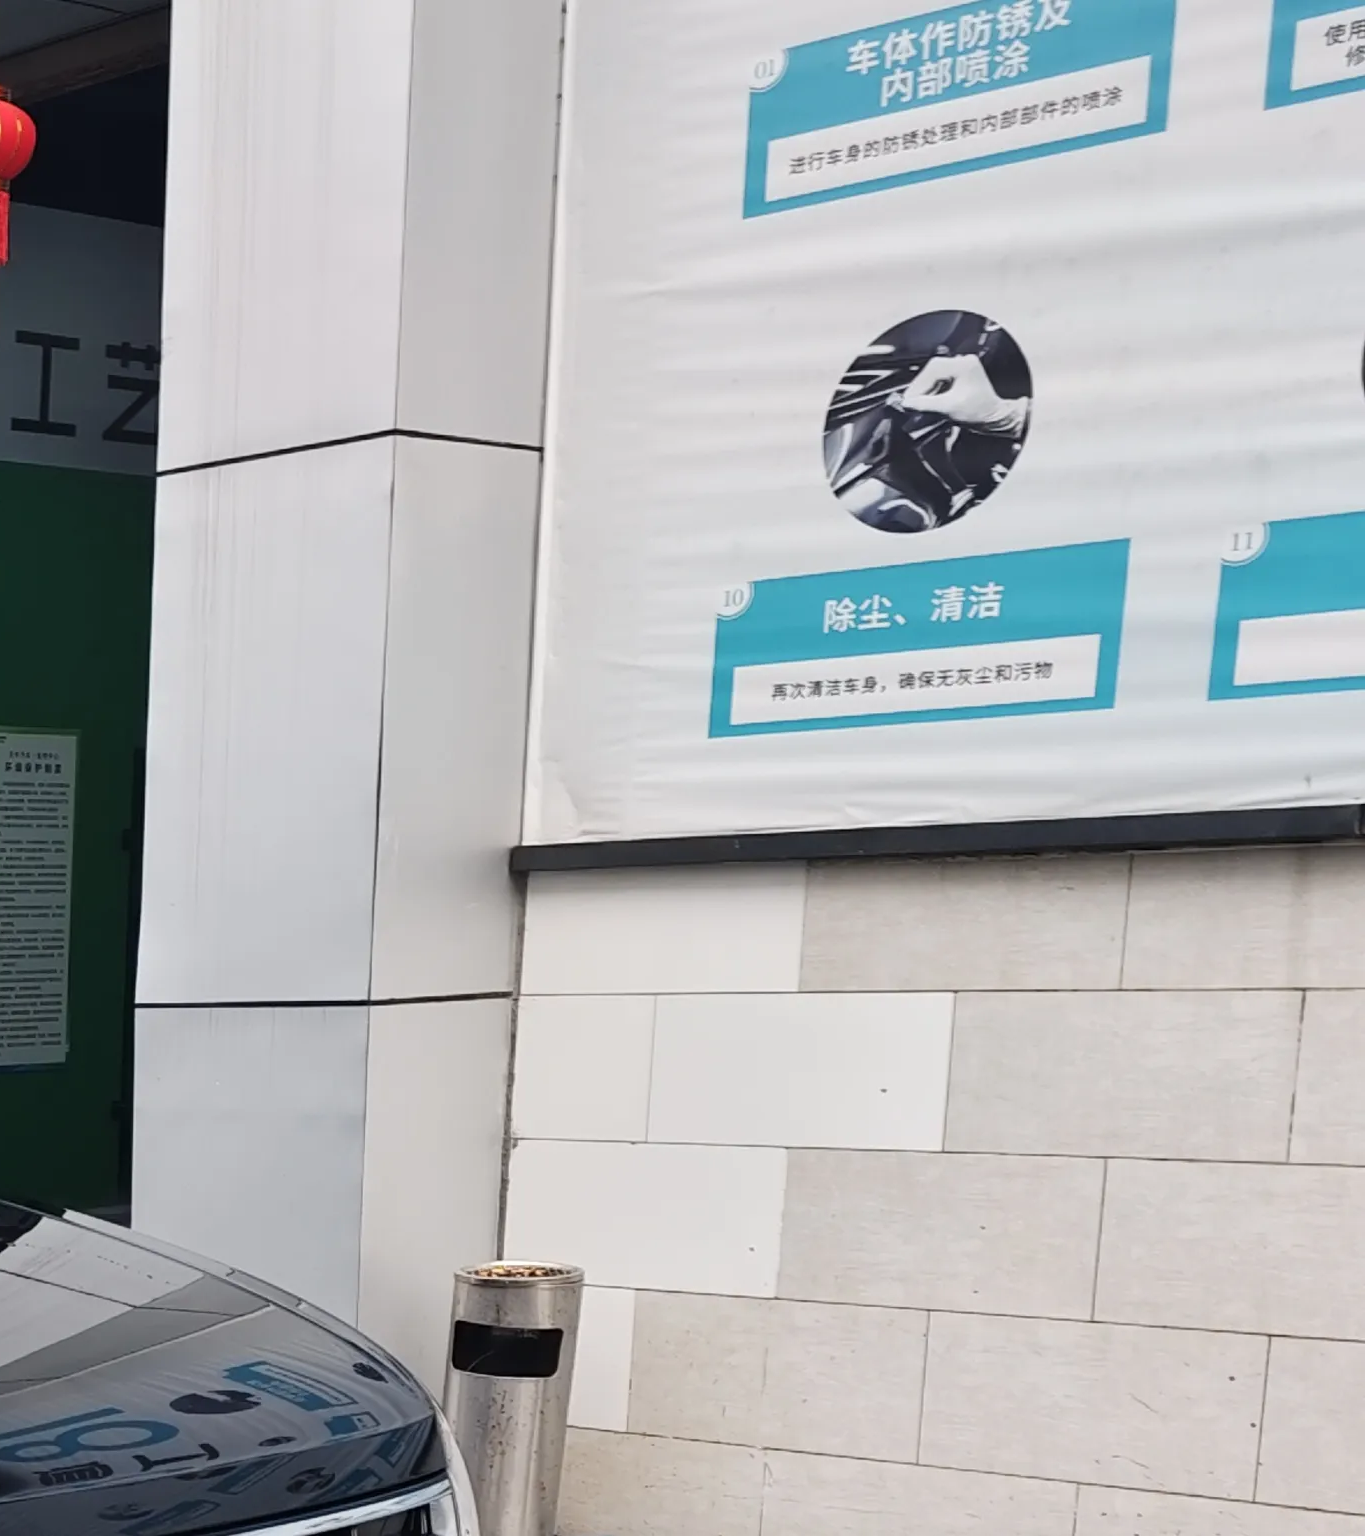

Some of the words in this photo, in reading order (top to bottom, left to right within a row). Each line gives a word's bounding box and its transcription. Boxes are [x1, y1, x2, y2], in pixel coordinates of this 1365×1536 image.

[845, 0, 1072, 76] 车体作防锈及
[880, 40, 1031, 108] 内部喷涂
[789, 86, 1124, 176] 进行车身的防锈处理和内部部件的喷涂
[723, 589, 744, 607] 10
[823, 582, 1004, 633] 除尘、清洁
